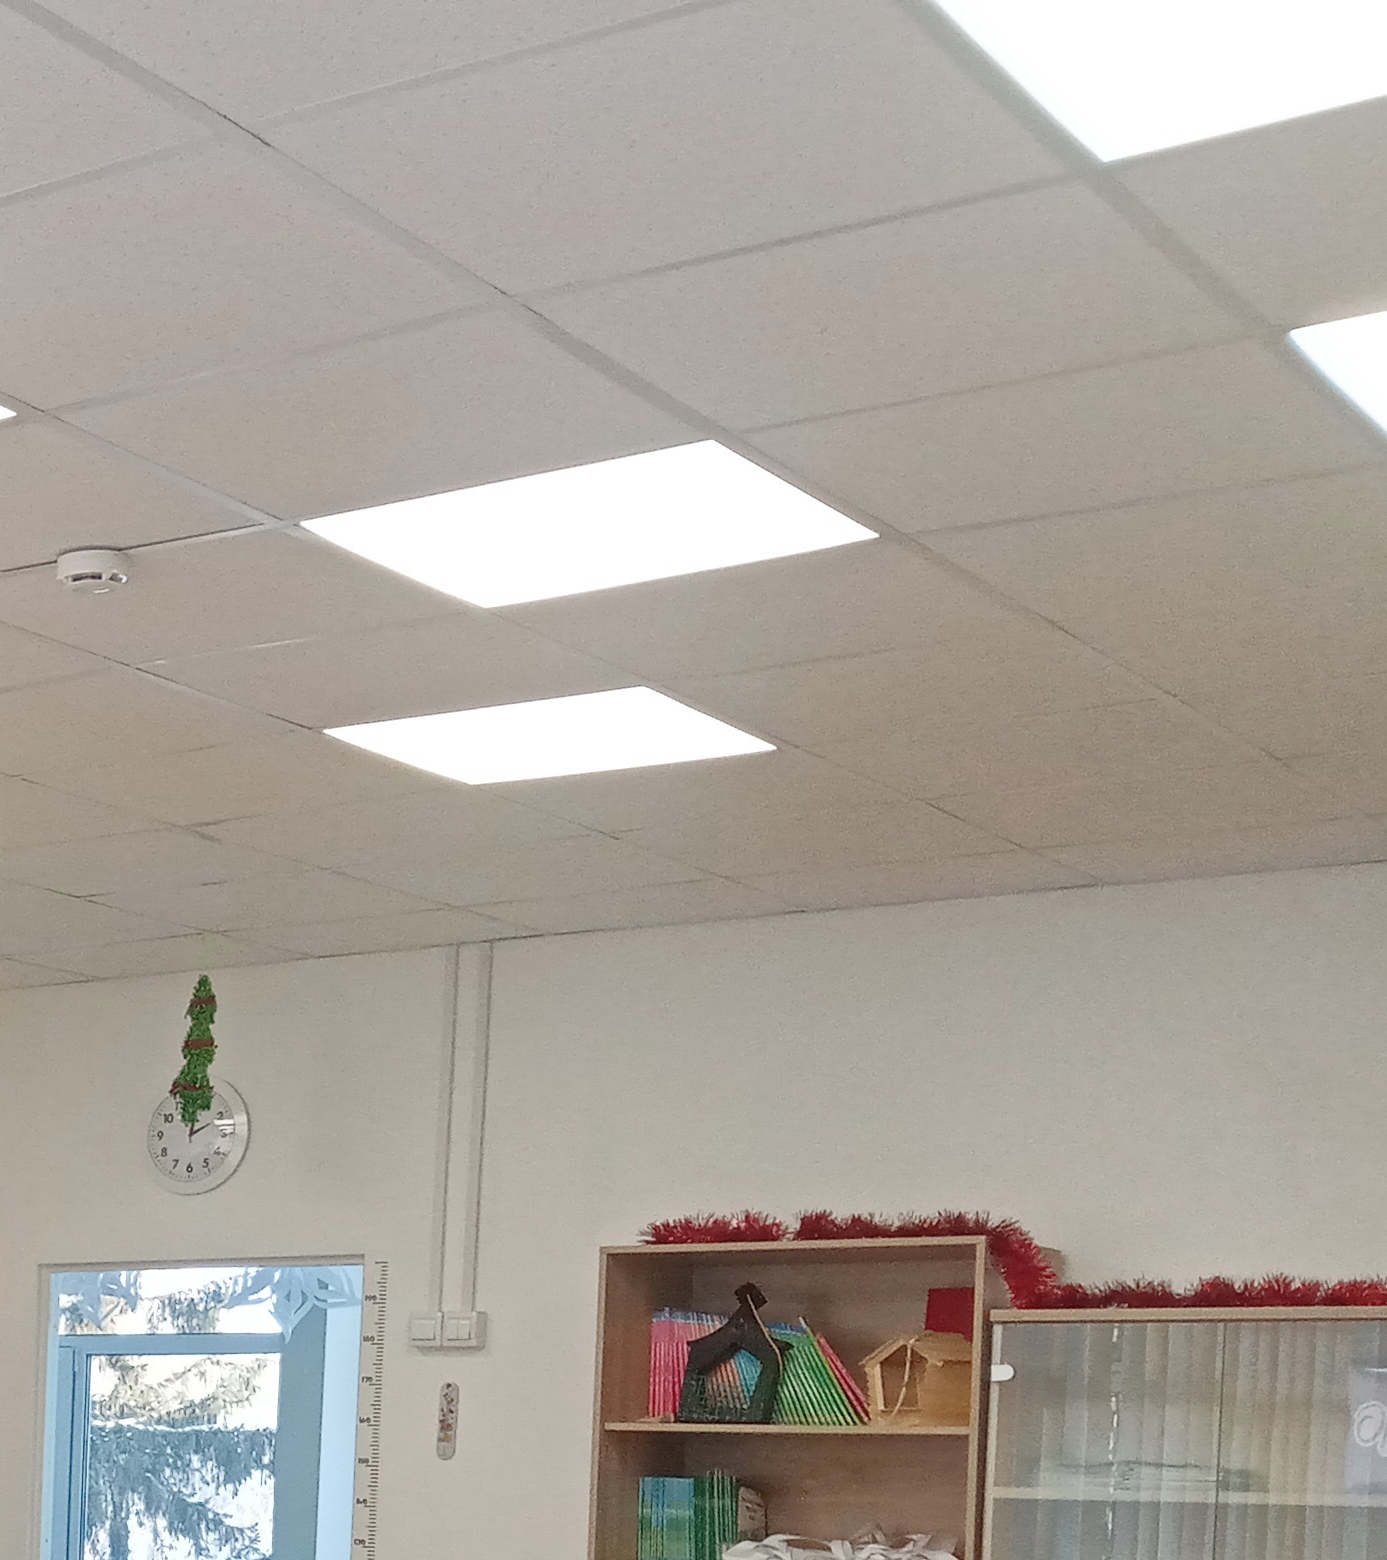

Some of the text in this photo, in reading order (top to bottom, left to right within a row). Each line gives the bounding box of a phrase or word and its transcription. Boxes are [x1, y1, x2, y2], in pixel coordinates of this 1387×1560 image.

[164, 1113, 174, 1124] 10
[157, 1130, 164, 1141] 9
[160, 1147, 168, 1157] 8
[172, 1159, 179, 1169] 7
[186, 1162, 193, 1173] 6
[202, 1158, 210, 1168] 5
